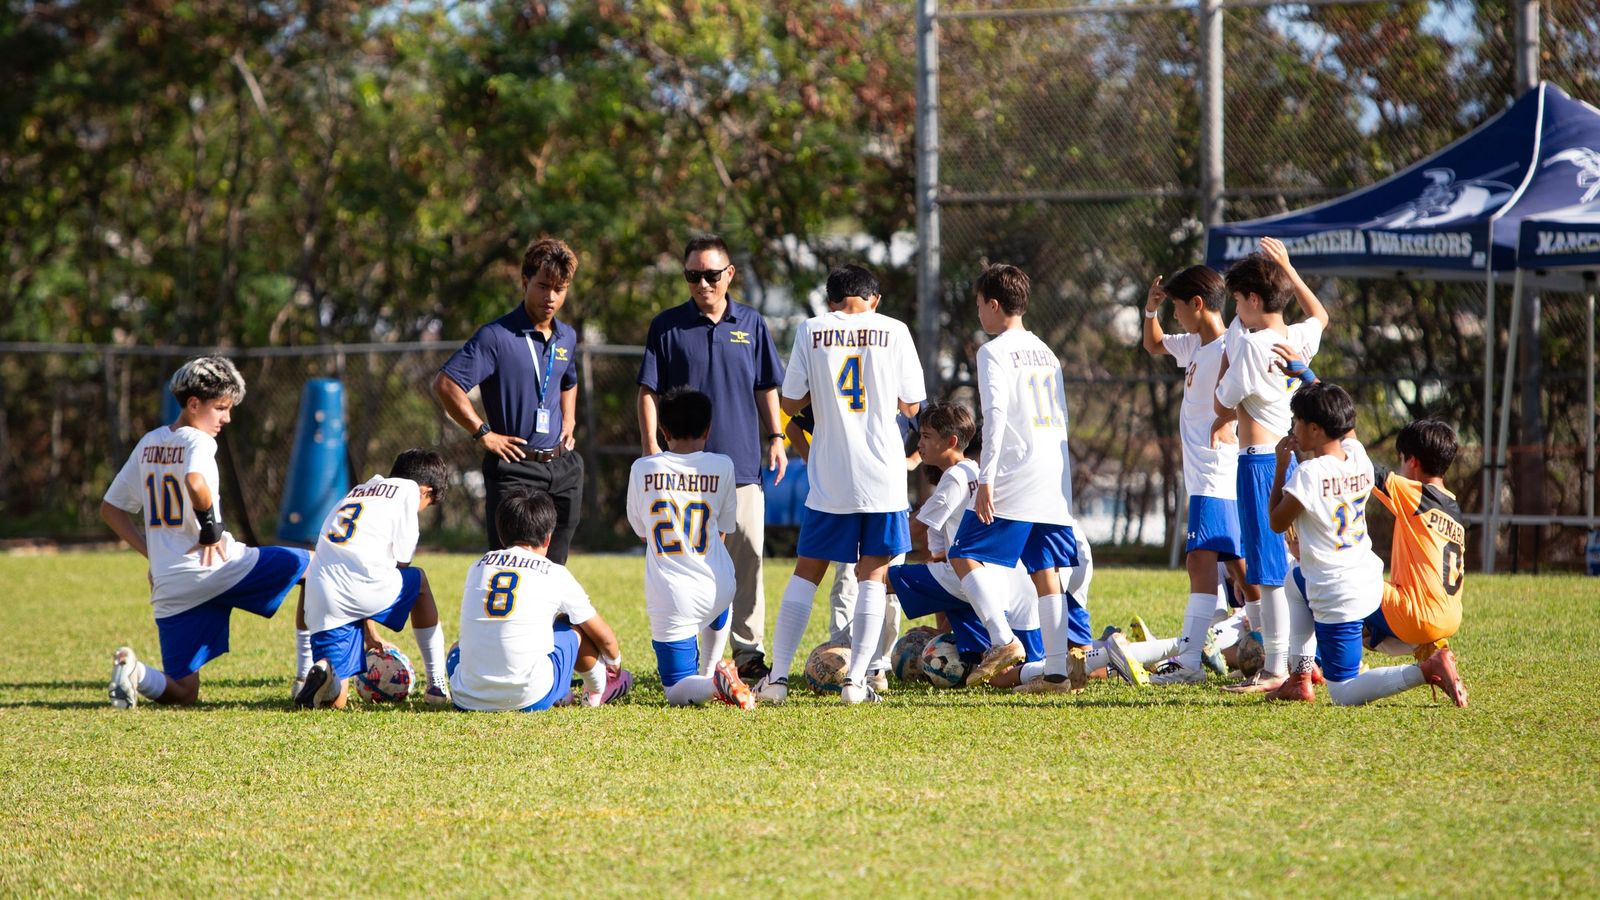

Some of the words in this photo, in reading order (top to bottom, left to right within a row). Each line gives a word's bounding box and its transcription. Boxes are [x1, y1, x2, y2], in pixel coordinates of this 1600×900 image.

[1369, 230, 1472, 257] WARRIORS
[812, 328, 890, 349] PUNAHOU
[836, 354, 866, 413] 4
[1029, 372, 1063, 427] 11
[145, 471, 185, 529] 10
[644, 473, 719, 493] PUNAHOU
[326, 502, 364, 545] 3
[649, 498, 712, 556] 20
[477, 553, 551, 575] PUNAHOU
[1443, 541, 1463, 596] 0
[484, 569, 522, 619] 8
